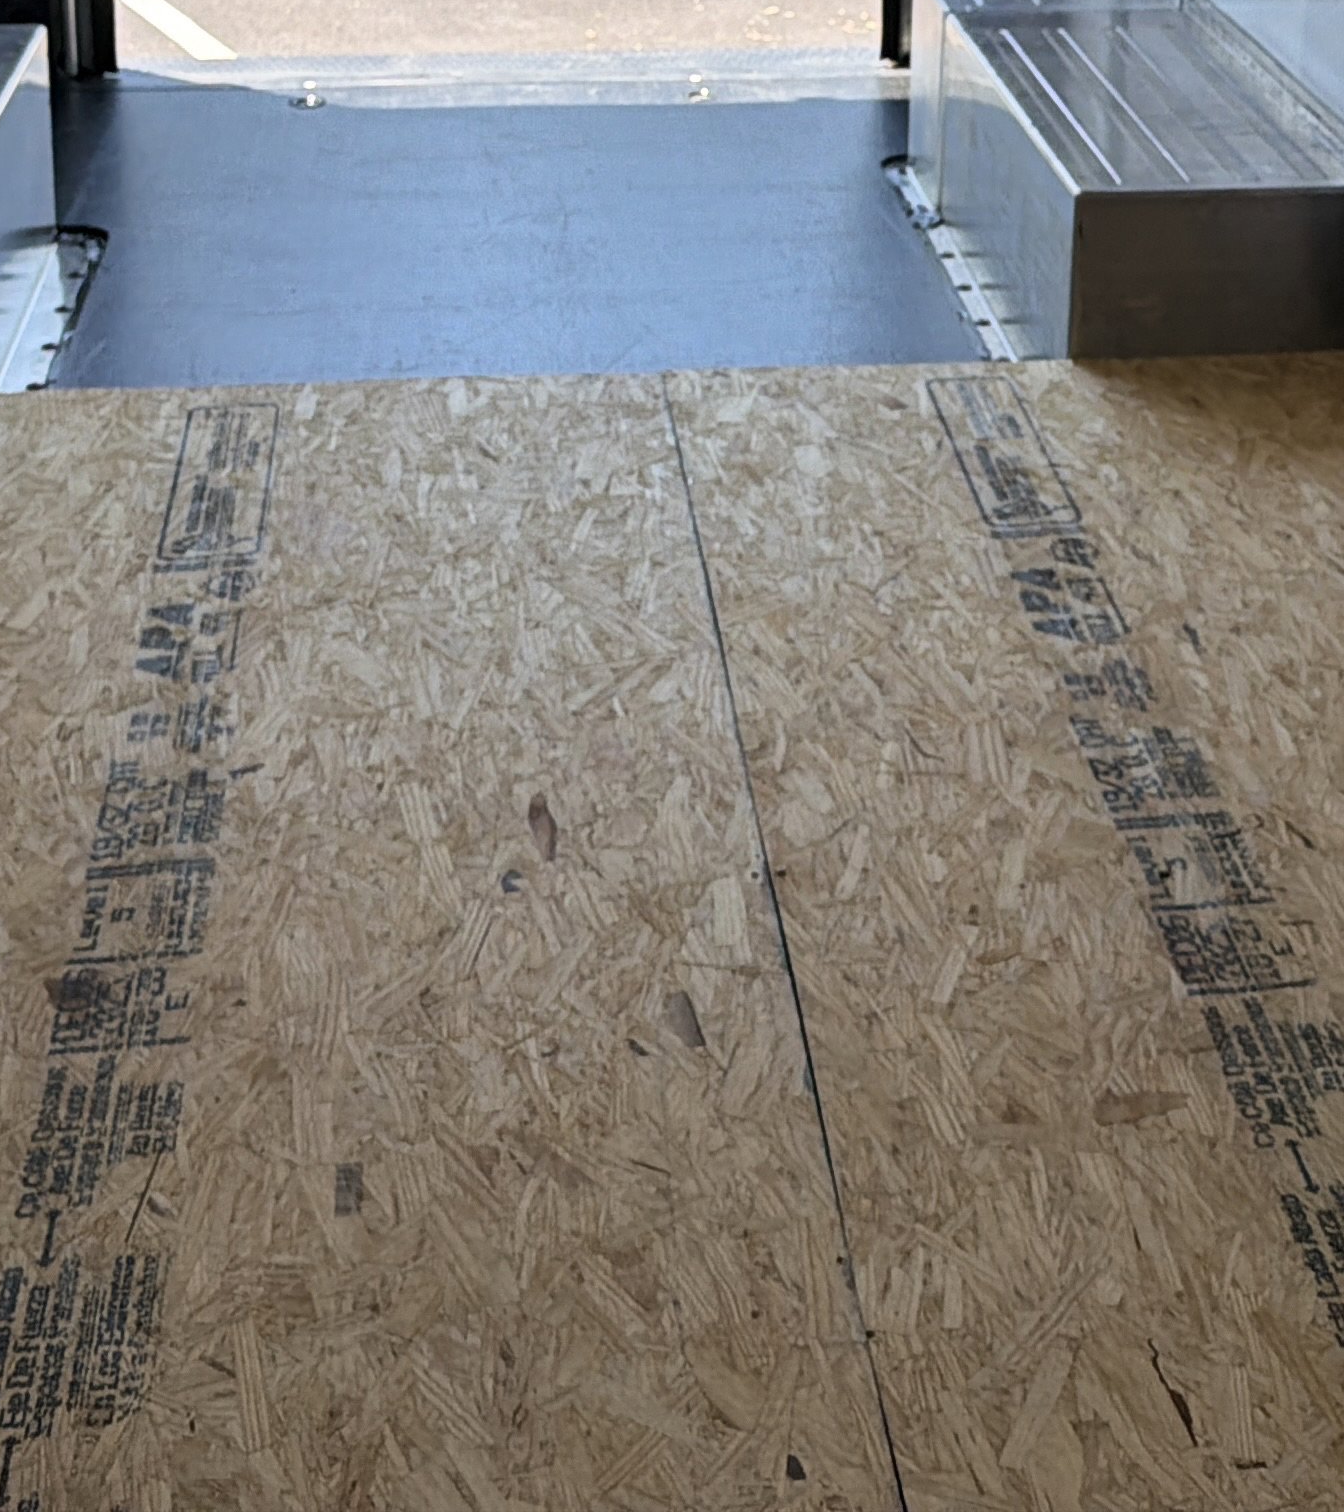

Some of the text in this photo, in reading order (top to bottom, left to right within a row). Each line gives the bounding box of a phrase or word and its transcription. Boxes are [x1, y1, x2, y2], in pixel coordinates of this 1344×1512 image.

[1126, 835, 1171, 900] Level
[73, 885, 108, 952] Level
[1252, 1071, 1277, 1094] De
[53, 1135, 78, 1160] De
[1249, 1122, 1274, 1148] Ce
[1303, 1248, 1340, 1298] Lado
[12, 1284, 50, 1353] Fuerza
[5, 1356, 36, 1388] De
